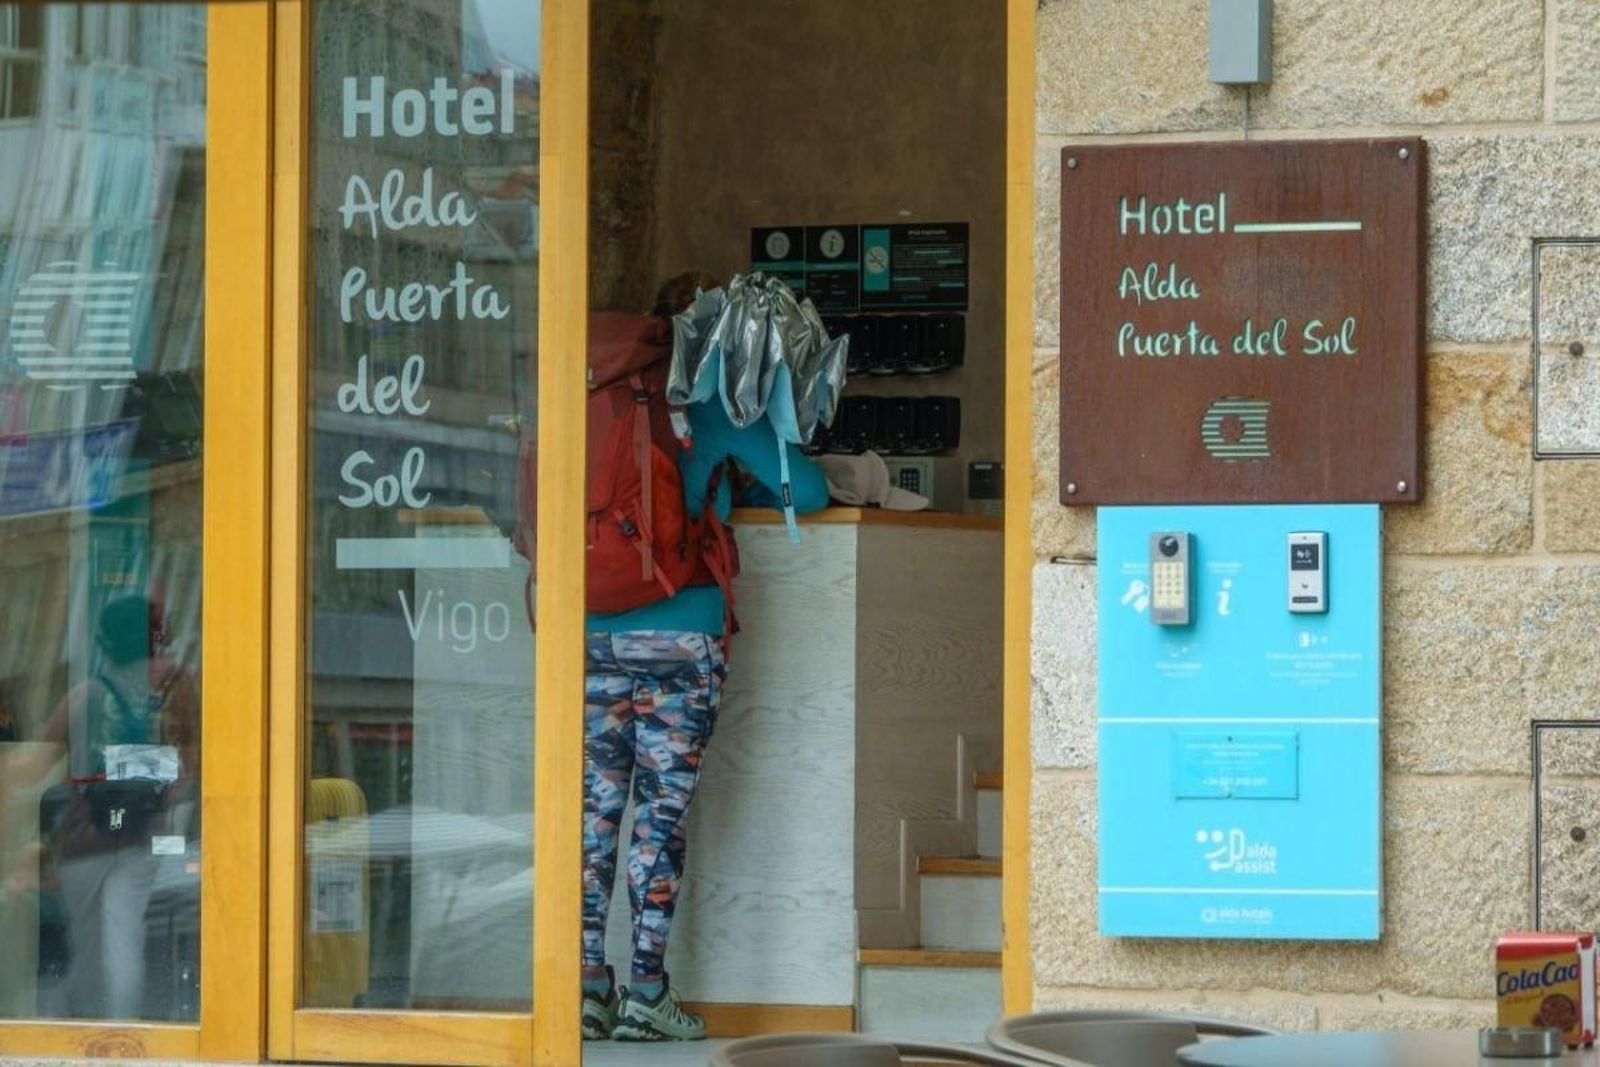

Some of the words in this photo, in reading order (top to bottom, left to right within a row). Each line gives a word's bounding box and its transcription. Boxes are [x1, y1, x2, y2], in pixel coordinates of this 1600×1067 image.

[343, 68, 515, 138] Hotel
[338, 167, 477, 240] Alda
[1119, 192, 1227, 235] Hotel
[340, 261, 510, 323] Puerta
[1118, 262, 1201, 305] Alda
[1118, 320, 1221, 357] Puerta
[1232, 318, 1288, 357] del
[1301, 317, 1358, 356] Sol
[337, 354, 431, 416] del
[338, 447, 431, 508] Sol
[398, 589, 511, 654] Vigo
[1497, 961, 1579, 996] ColaCao
